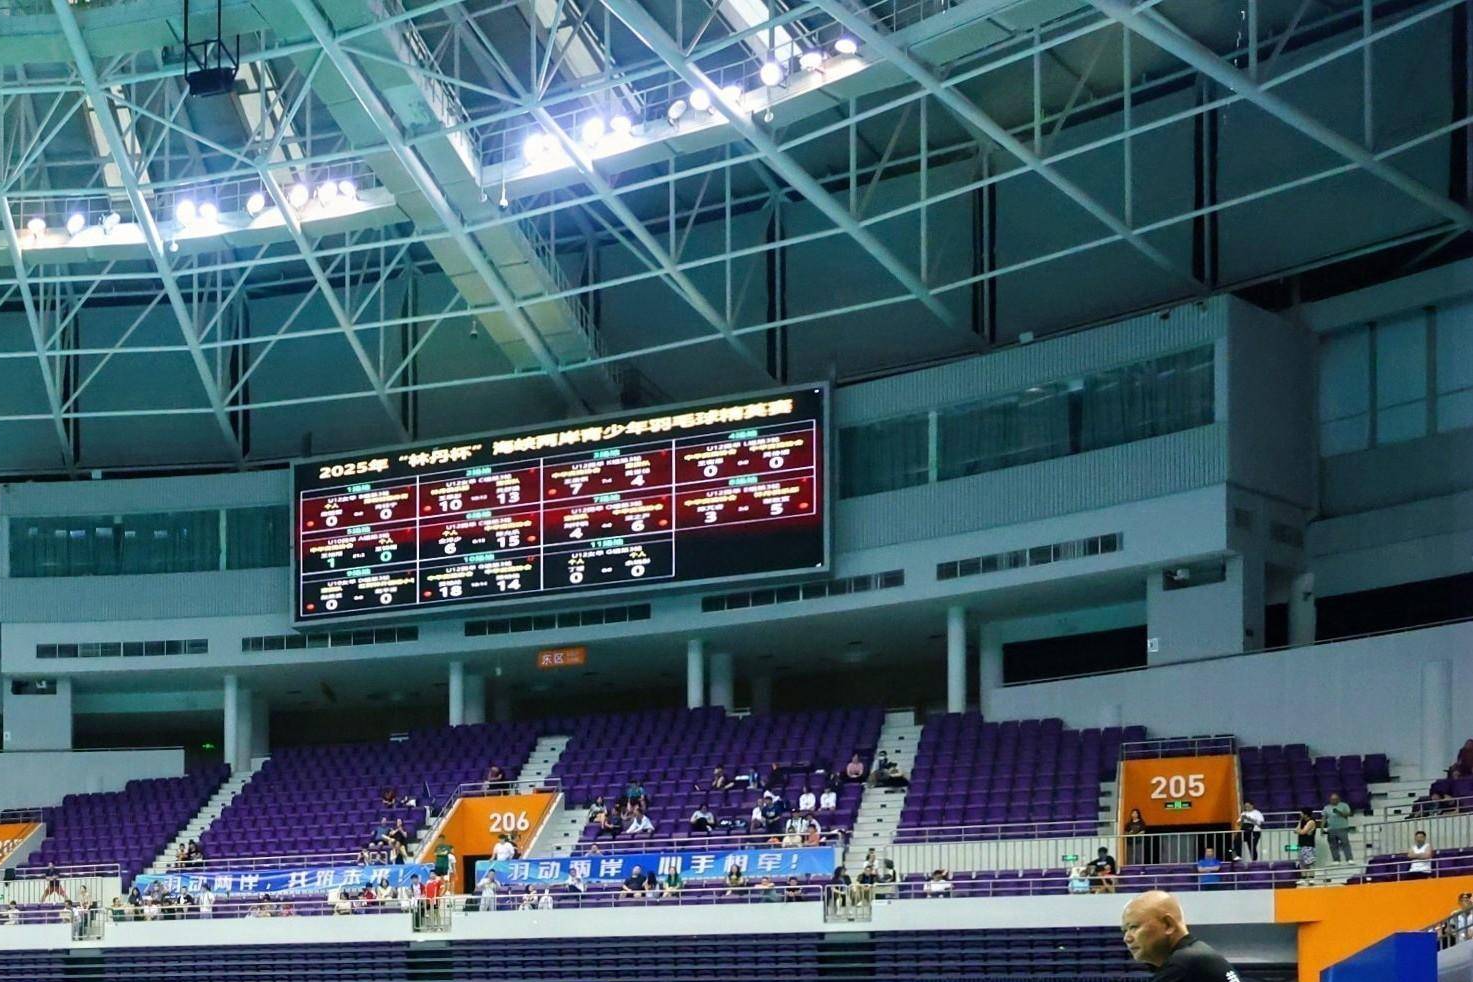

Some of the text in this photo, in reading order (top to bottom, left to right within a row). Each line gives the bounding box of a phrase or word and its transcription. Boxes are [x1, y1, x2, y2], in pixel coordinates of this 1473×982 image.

[319, 458, 389, 479] 2025年
[769, 457, 784, 469] 0
[704, 465, 718, 477] 0
[630, 475, 645, 486] 4
[570, 483, 583, 495] 7
[496, 492, 520, 504] 13
[439, 499, 462, 512] 10
[770, 503, 783, 515] 5
[380, 508, 392, 519] 0
[704, 511, 717, 523] 3
[326, 516, 338, 527] 0
[631, 520, 645, 532] 6
[569, 528, 583, 539] 4
[496, 535, 520, 548] 15
[444, 543, 456, 554] 6
[380, 551, 392, 562] 0
[327, 558, 335, 568] 1
[631, 565, 645, 577] 0
[570, 572, 583, 583] 0
[496, 579, 521, 591] 14
[439, 585, 462, 598] 18
[326, 599, 338, 610] 0
[380, 593, 392, 604] 0
[1150, 774, 1205, 799] 205
[489, 812, 530, 834] 206
